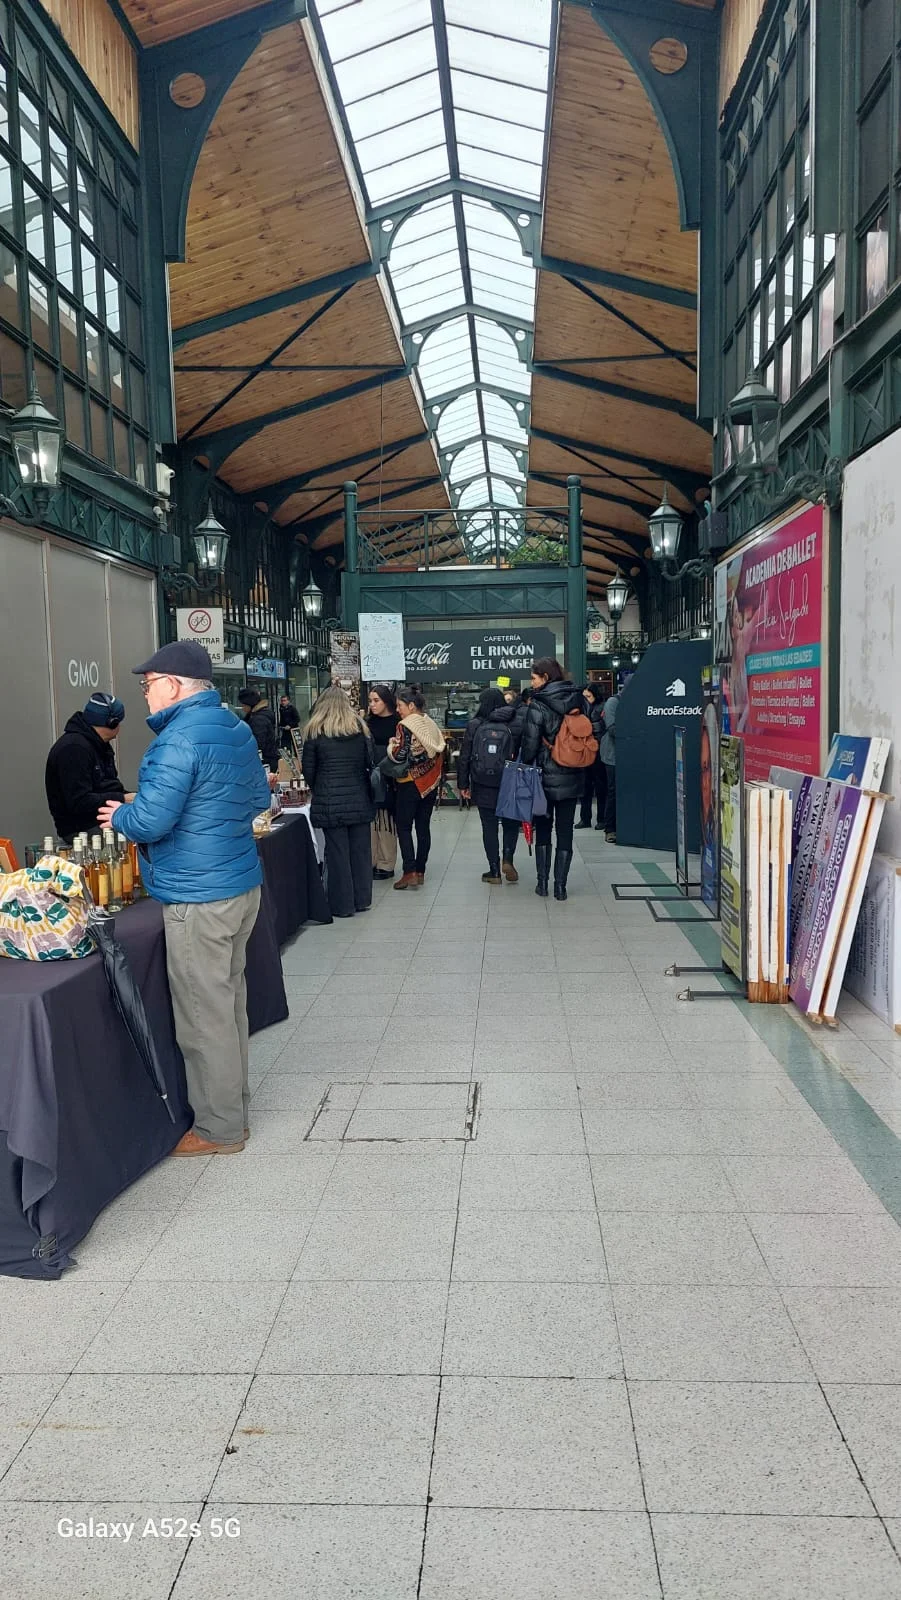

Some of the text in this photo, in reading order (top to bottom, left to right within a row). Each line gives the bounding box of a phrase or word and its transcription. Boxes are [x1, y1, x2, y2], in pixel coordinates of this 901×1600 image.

[745, 532, 817, 590] ACADEMIA DE BALLET
[404, 642, 453, 664] ca-Cola
[470, 642, 534, 656] EL RINCÓN
[68, 660, 99, 688] GMO
[472, 660, 496, 670] DEL
[800, 676, 812, 688] Ballet
[802, 694, 816, 707] Ballet
[793, 781, 808, 830] LOCAL
